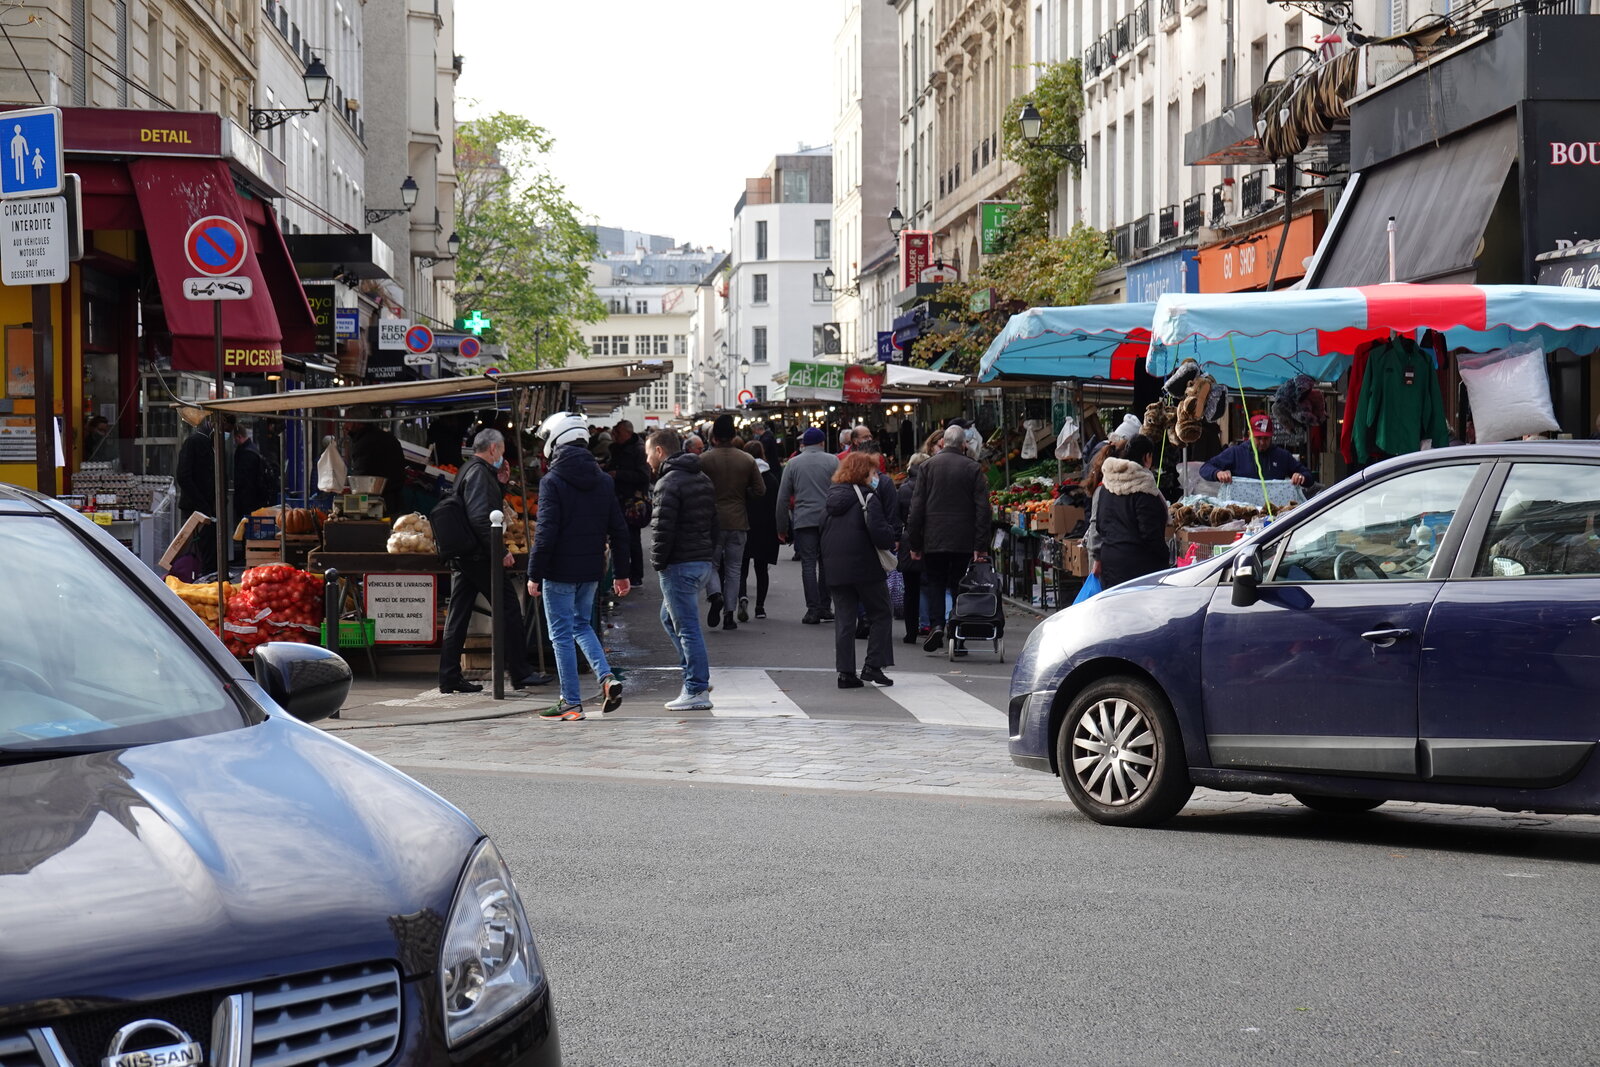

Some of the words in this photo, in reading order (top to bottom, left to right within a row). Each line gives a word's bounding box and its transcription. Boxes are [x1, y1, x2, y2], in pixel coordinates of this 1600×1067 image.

[141, 128, 192, 144] DETAIL
[1551, 142, 1600, 165] BOU
[4, 201, 55, 216] CIRCULATION
[11, 218, 52, 232] INTERDITE
[13, 238, 22, 247] AUX
[24, 236, 50, 247] VÉHICULES
[26, 259, 38, 267] SAUF
[1223, 252, 1233, 280] GO
[1239, 246, 1256, 276] SHOP
[11, 270, 34, 279] DESSERTE
[35, 268, 56, 278] INTERNE
[381, 325, 407, 333] FRED
[224, 348, 271, 367] EPICES
[790, 368, 812, 386] AB
[817, 371, 840, 388] AB
[115, 1048, 194, 1067] NISSAN
